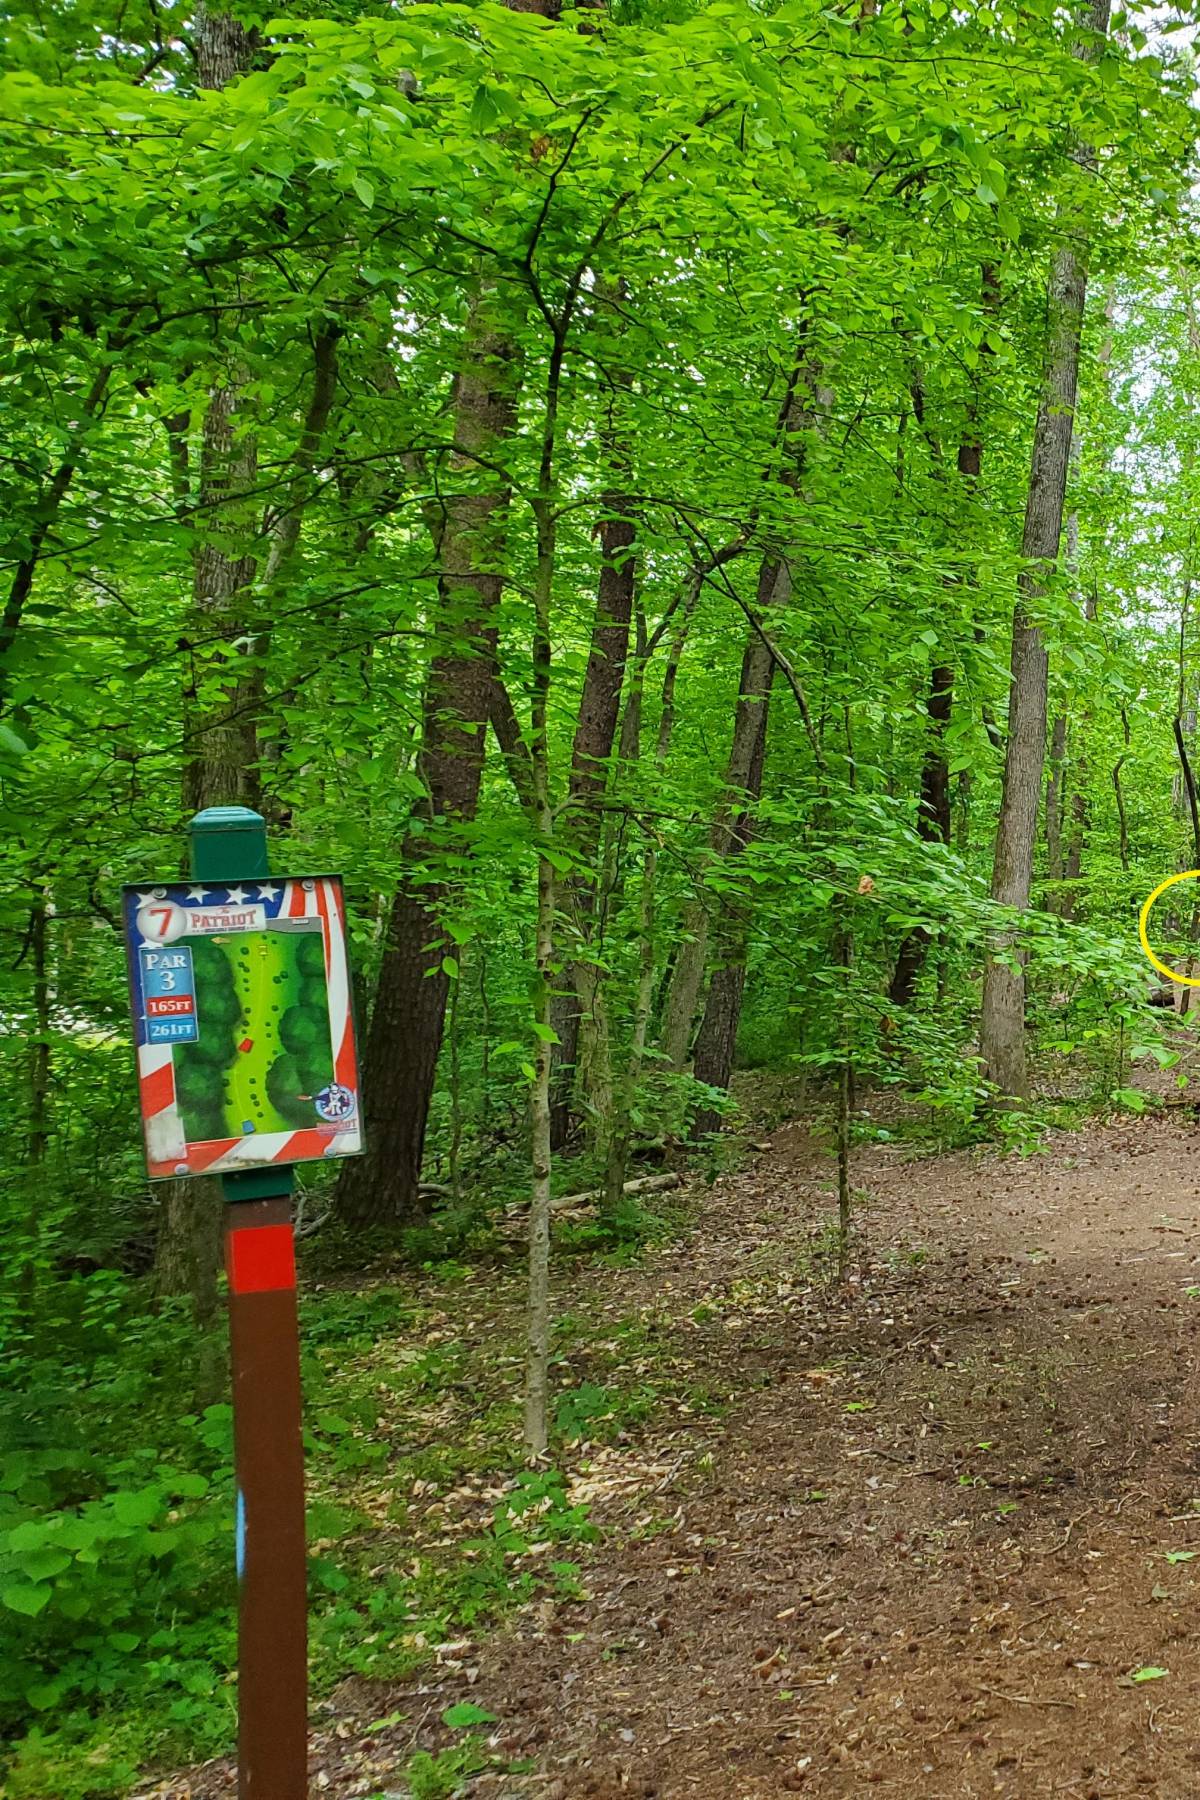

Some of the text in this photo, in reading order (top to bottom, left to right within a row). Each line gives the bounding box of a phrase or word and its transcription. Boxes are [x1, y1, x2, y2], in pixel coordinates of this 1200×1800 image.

[150, 908, 172, 937] 7
[191, 911, 257, 928] PATRIOT
[160, 971, 175, 991] 3
[150, 1001, 191, 1013] 165FT
[151, 1024, 192, 1037] 261FT
